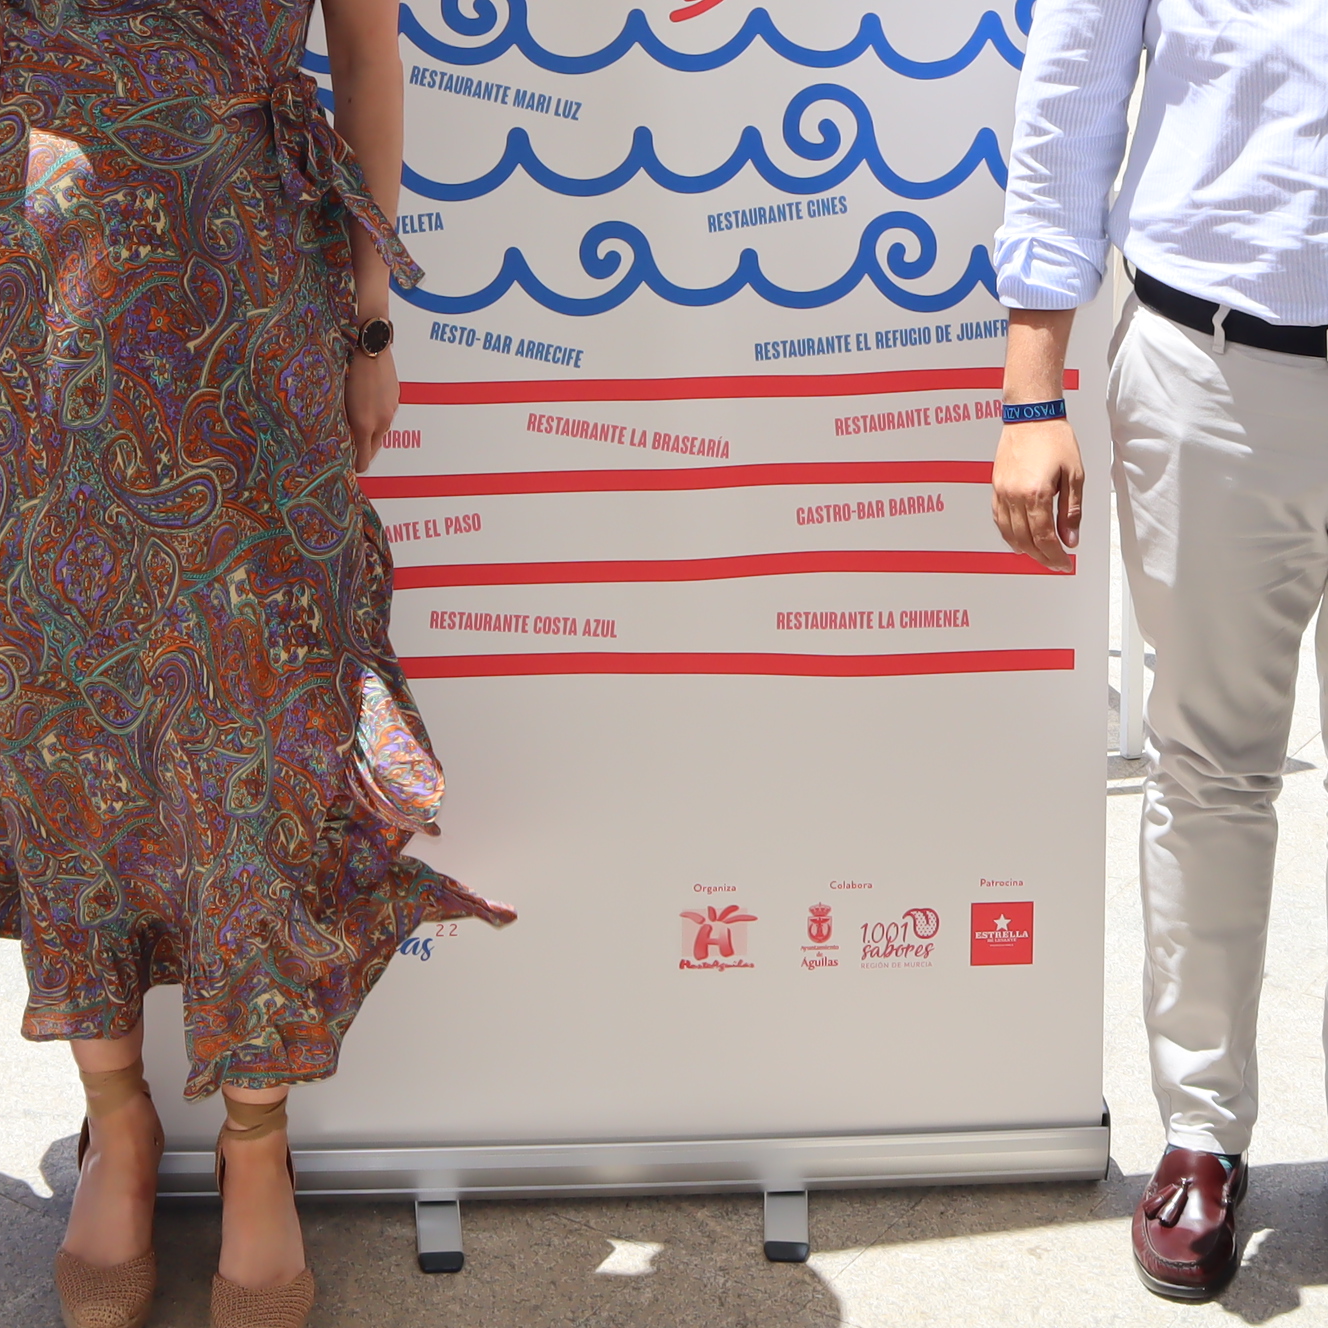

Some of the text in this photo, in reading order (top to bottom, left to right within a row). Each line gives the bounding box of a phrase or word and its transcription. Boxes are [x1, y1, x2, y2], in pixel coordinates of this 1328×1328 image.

[409, 66, 583, 121] RESTAURANTE MARI LUZ
[708, 195, 848, 233] RESTAURANTE GINES
[755, 319, 1008, 361] RESTAURANTE EL REFUGIO DE JUANFR
[515, 338, 583, 369] ARRECIFE
[835, 399, 1003, 436] RESTAURANTE CASA BAR
[383, 430, 421, 448] URON
[526, 413, 730, 459] RESTAURANTE LA BRASEARÍA
[796, 494, 945, 526] GASTRO-BAR BARRA6
[424, 519, 442, 539] EL
[444, 513, 482, 536] PASO
[429, 611, 617, 638] RESTAURANTE COSTA AZUL
[776, 609, 970, 630] RESTAURANTE LA CHIMENEA
[693, 883, 737, 895] Organiza
[830, 880, 873, 889] Colabora
[980, 878, 1024, 887] Patrocina
[861, 936, 935, 960] sabores
[975, 931, 1029, 939] ESTRELLA
[860, 961, 889, 969] REGIÓN
